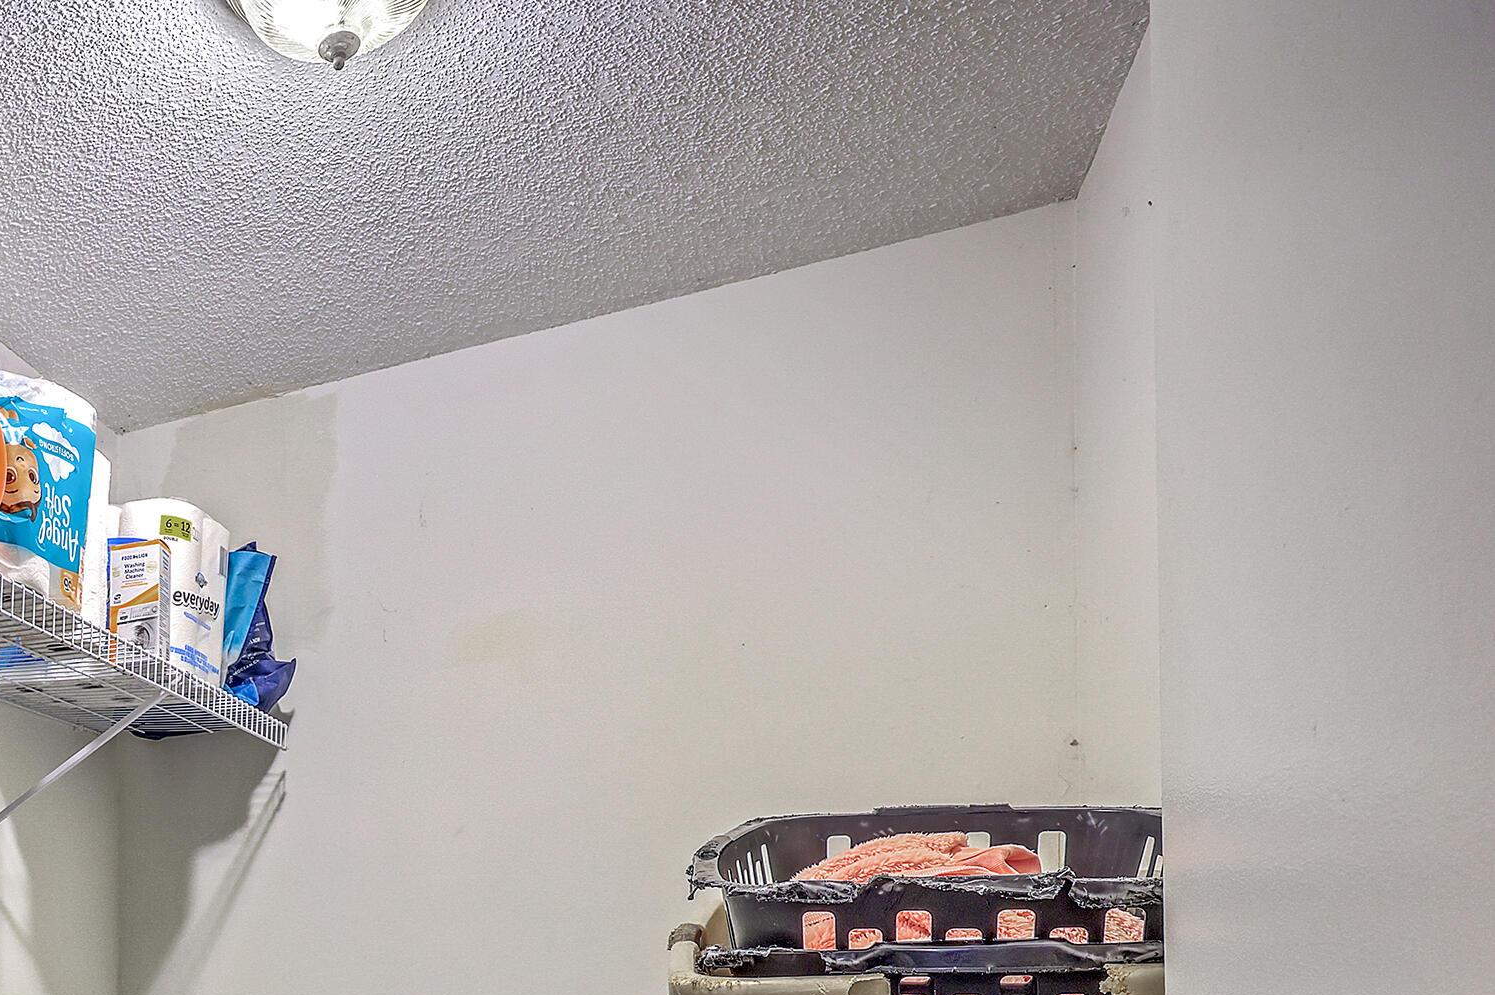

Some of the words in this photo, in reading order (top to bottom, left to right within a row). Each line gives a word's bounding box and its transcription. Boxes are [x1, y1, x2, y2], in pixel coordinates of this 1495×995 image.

[44, 482, 72, 528] Soft
[37, 510, 79, 562] Angel
[166, 518, 172, 528] 6
[181, 521, 191, 534] 12
[172, 589, 221, 617] everyday
